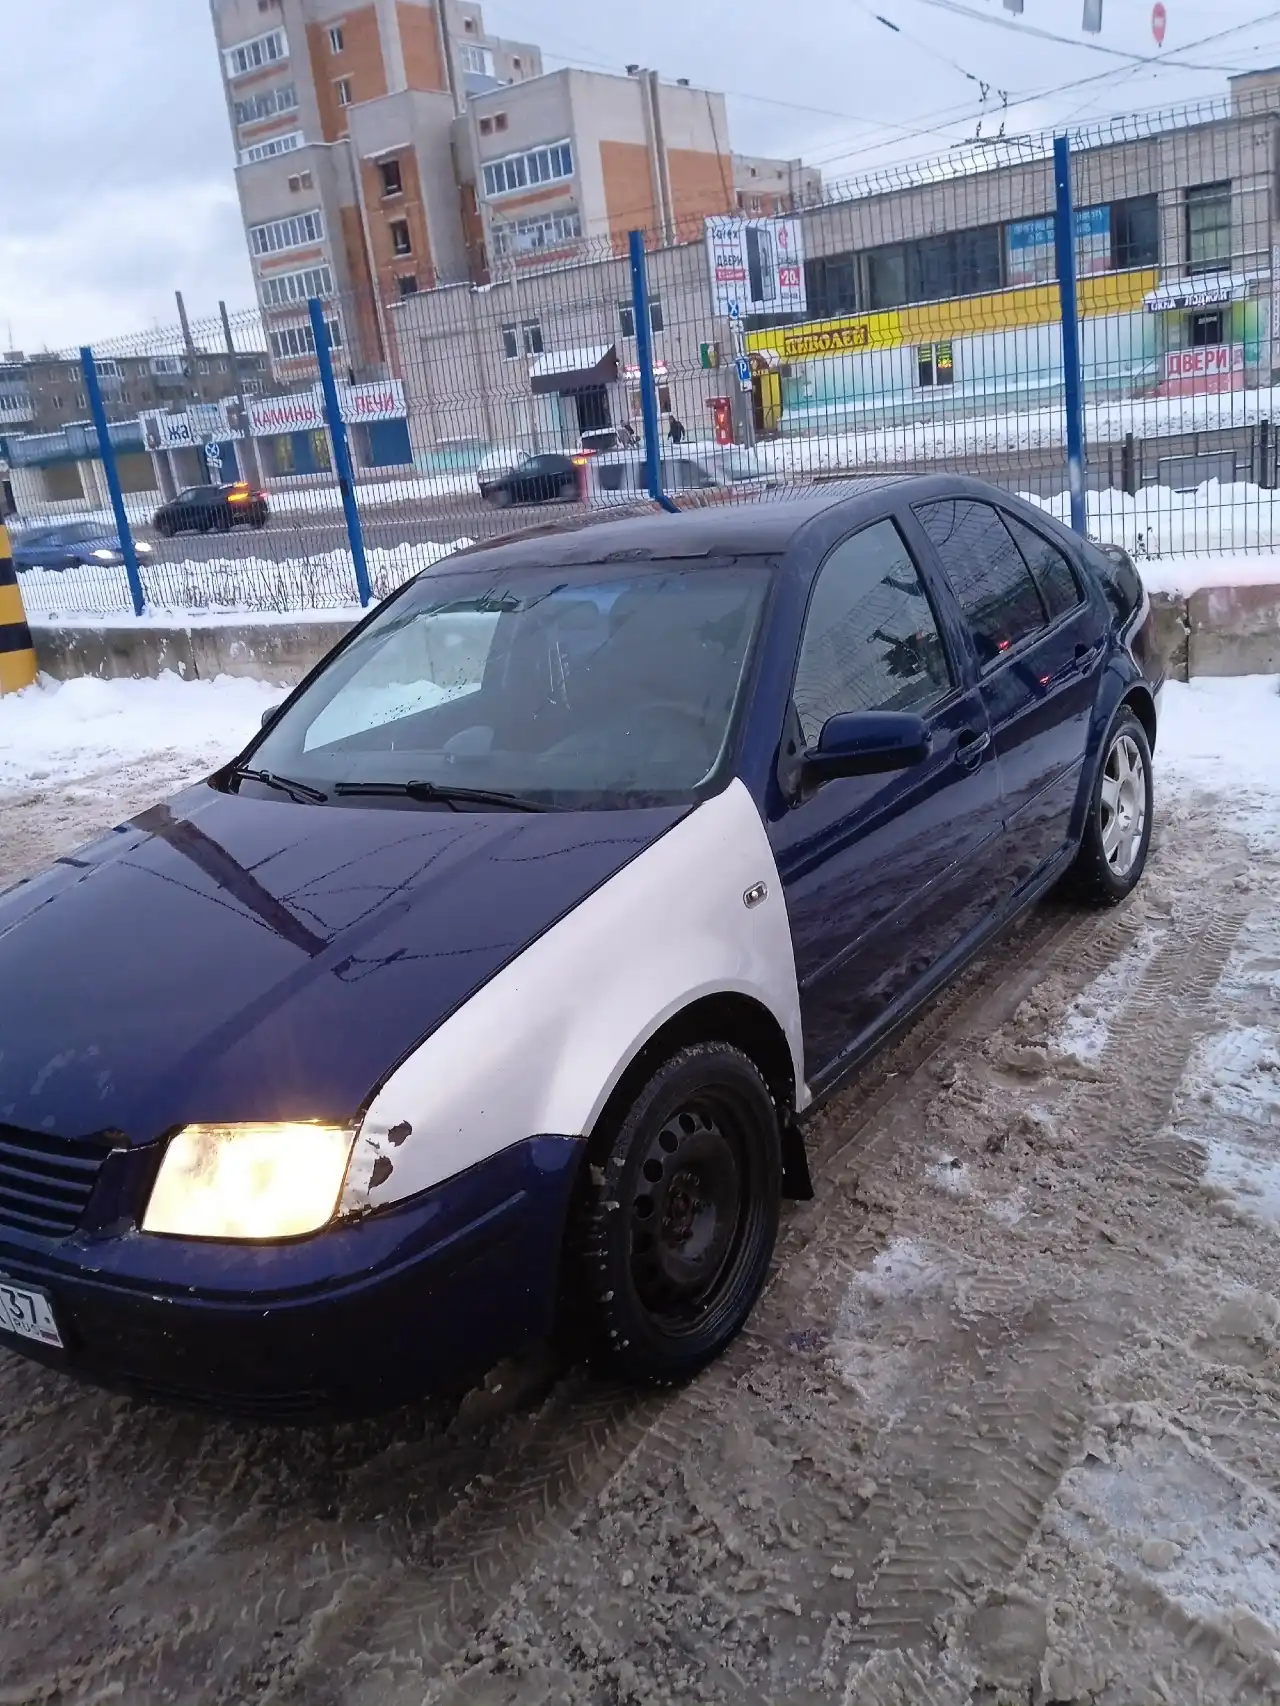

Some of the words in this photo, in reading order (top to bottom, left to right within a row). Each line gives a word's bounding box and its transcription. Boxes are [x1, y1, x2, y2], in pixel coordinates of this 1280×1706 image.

[717, 254, 743, 267] ДВЕРИ
[1169, 349, 1227, 376] ДВЕРИ
[252, 403, 318, 429] КАМИНЫ
[354, 392, 395, 415] ПЕЧИ
[1, 1288, 37, 1324] 37
